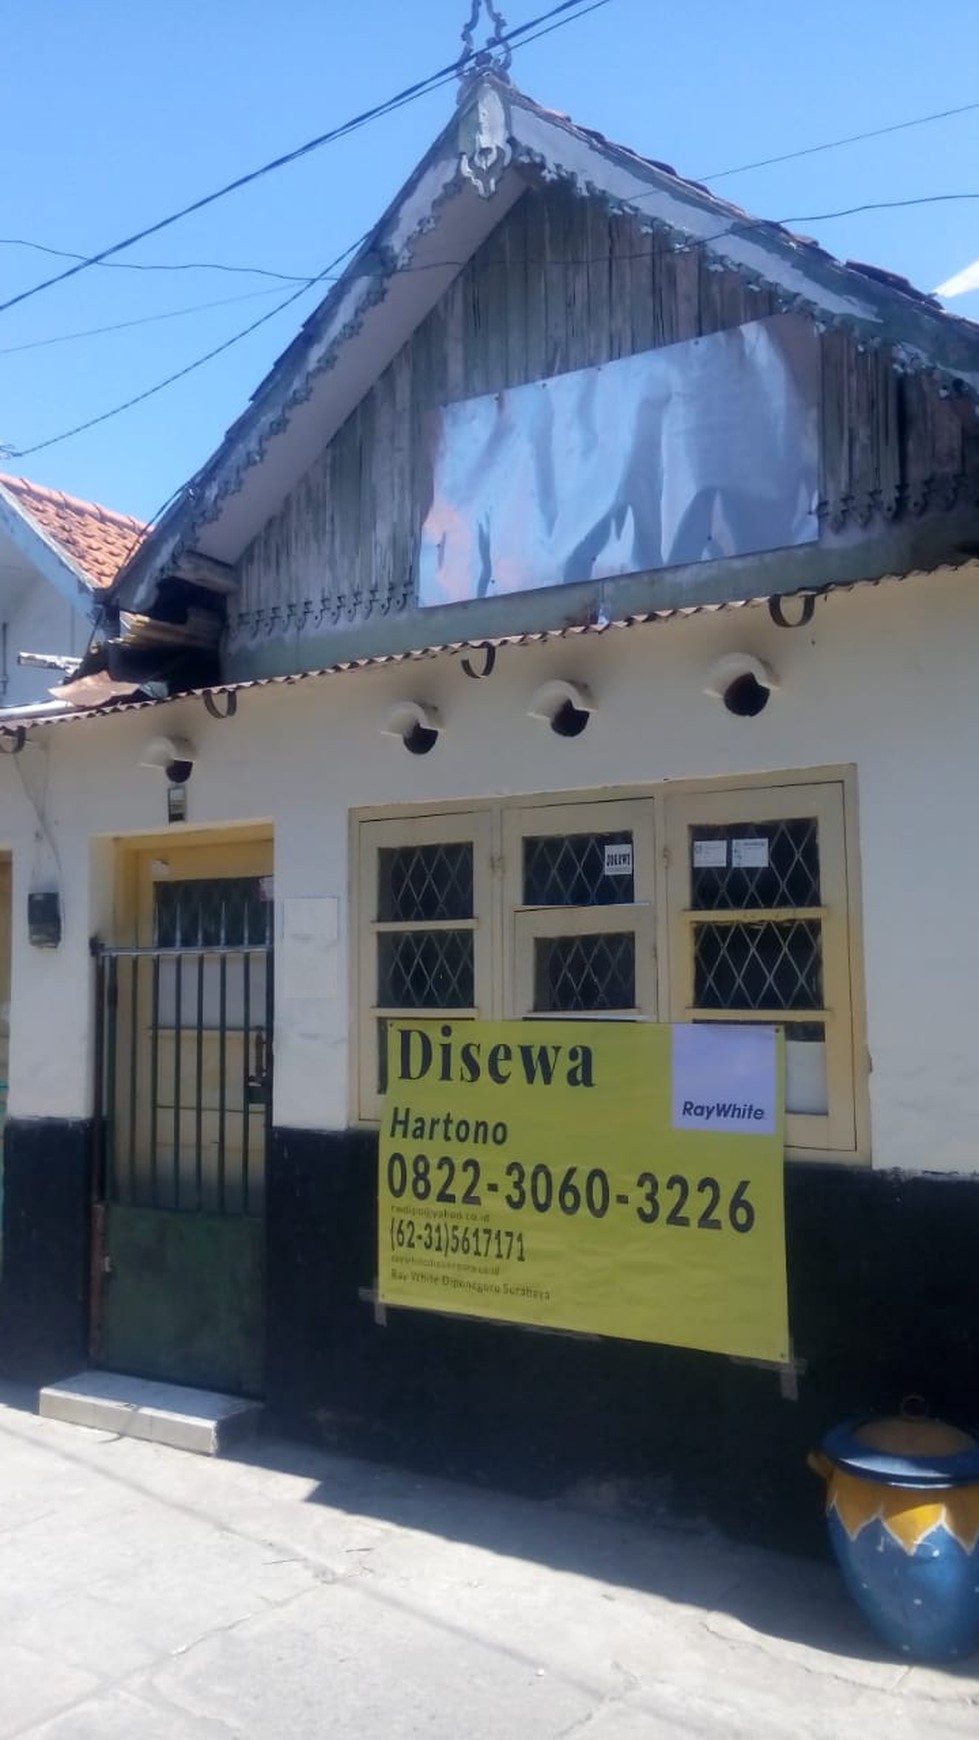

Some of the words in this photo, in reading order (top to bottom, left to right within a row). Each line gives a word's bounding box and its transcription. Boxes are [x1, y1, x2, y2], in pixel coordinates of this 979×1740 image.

[398, 1025, 595, 1087] Disewa
[390, 1106, 508, 1146] Hartono
[682, 1101, 764, 1120] RayWhite
[387, 1152, 755, 1234] 0822-3060-3226
[390, 1217, 525, 1262] (62-31)5617171
[411, 1272, 439, 1286] White
